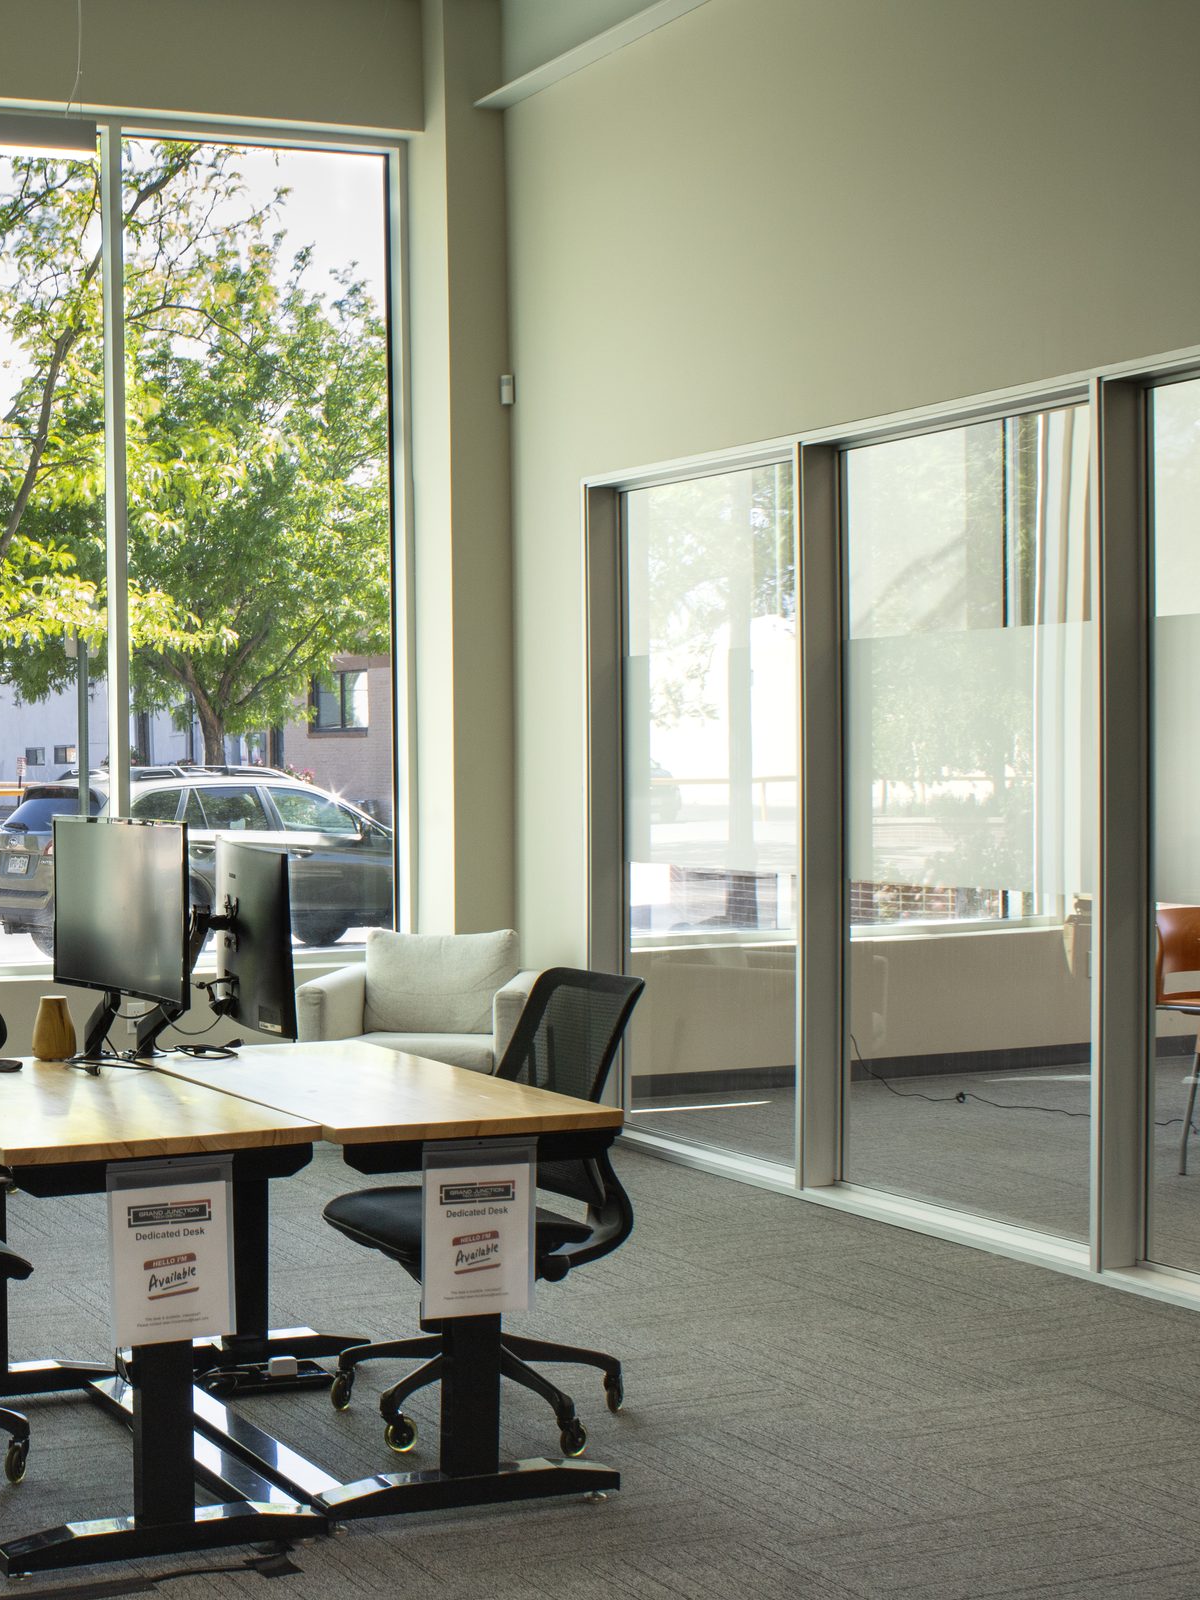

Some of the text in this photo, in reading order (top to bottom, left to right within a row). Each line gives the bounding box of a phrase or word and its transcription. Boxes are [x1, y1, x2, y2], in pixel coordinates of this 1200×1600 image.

[446, 1206, 509, 1218] Dedicated Desk
[135, 1227, 205, 1241] Dedicated Desk
[460, 1235, 480, 1244] HELLO
[455, 1242, 499, 1266] Available
[152, 1258, 175, 1268] HELLO
[148, 1265, 196, 1292] Available
